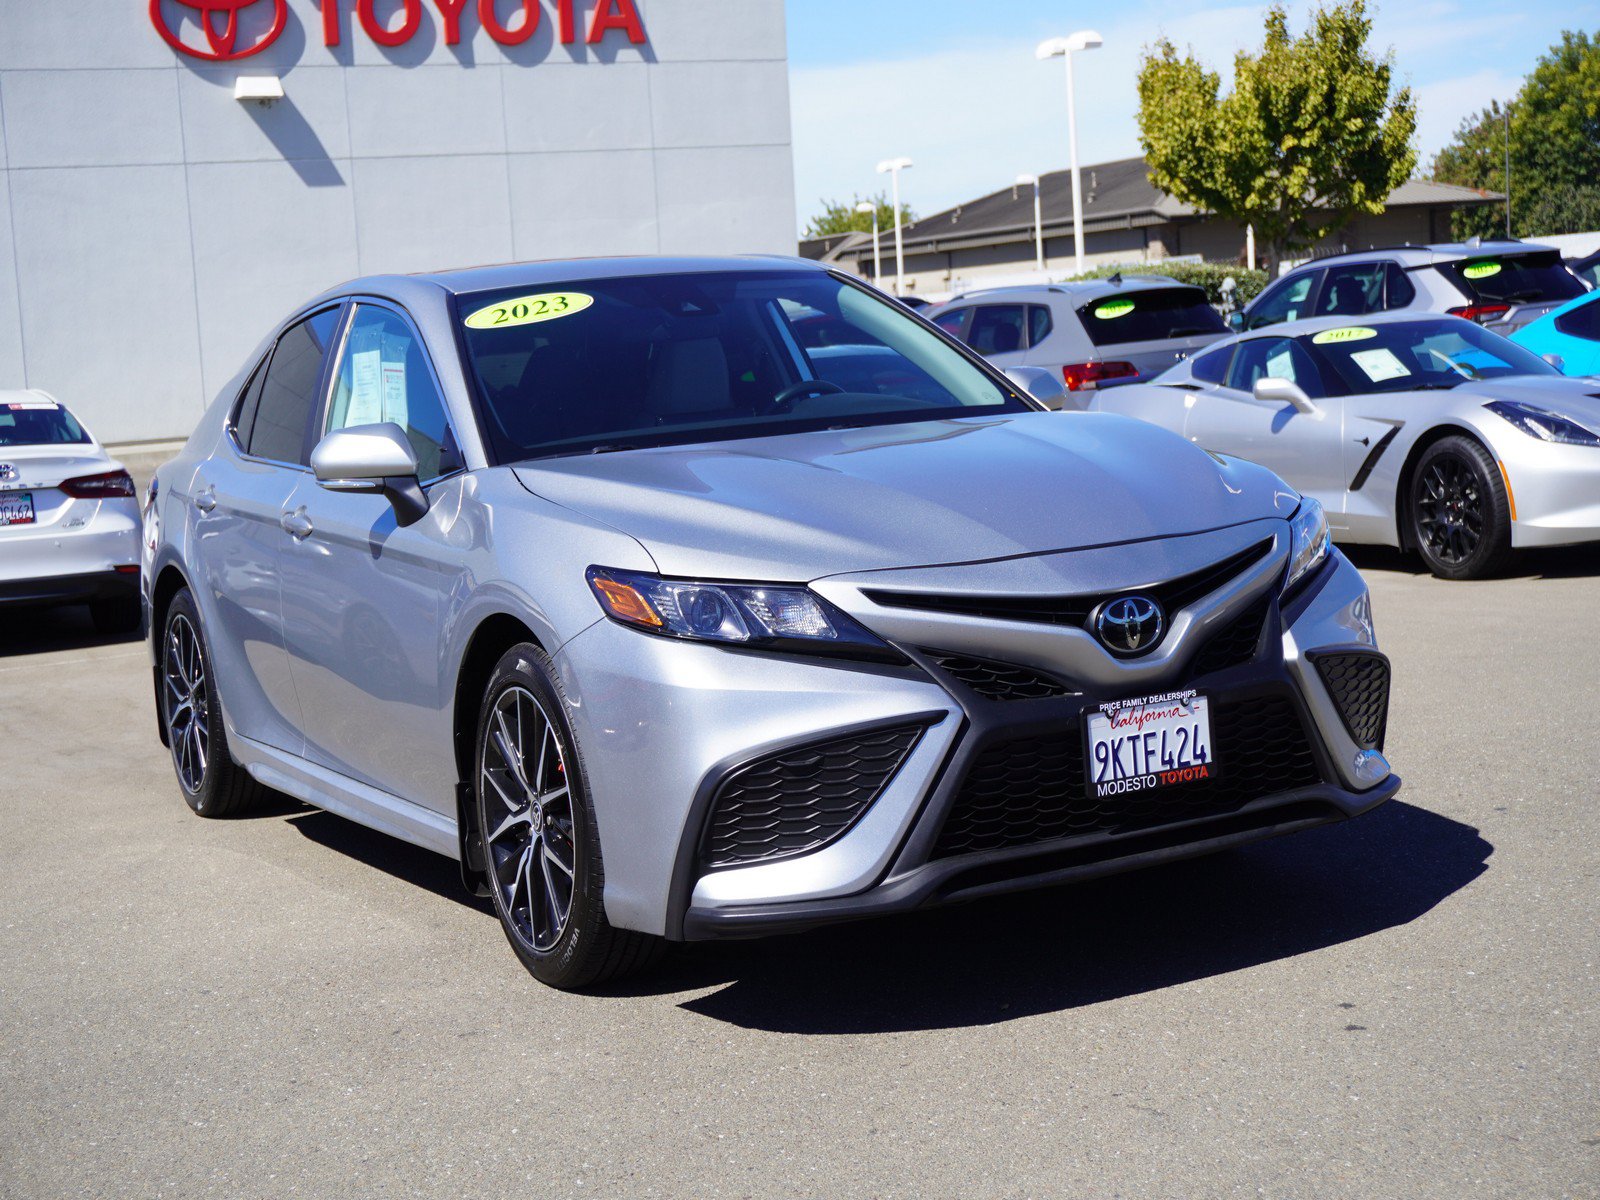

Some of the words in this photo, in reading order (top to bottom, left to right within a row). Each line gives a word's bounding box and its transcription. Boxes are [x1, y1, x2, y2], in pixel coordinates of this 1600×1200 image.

[320, 0, 646, 46] TOYOTA
[491, 296, 569, 325] 2023
[1099, 702, 1121, 712] PRICE
[1122, 697, 1147, 708] FAMILY
[1149, 689, 1197, 704] DEALERSHIPS
[1110, 704, 1189, 731] California
[1095, 724, 1207, 783] 9KTF424
[1097, 774, 1157, 797] MODESTO
[1160, 765, 1209, 785] TOYOTA
